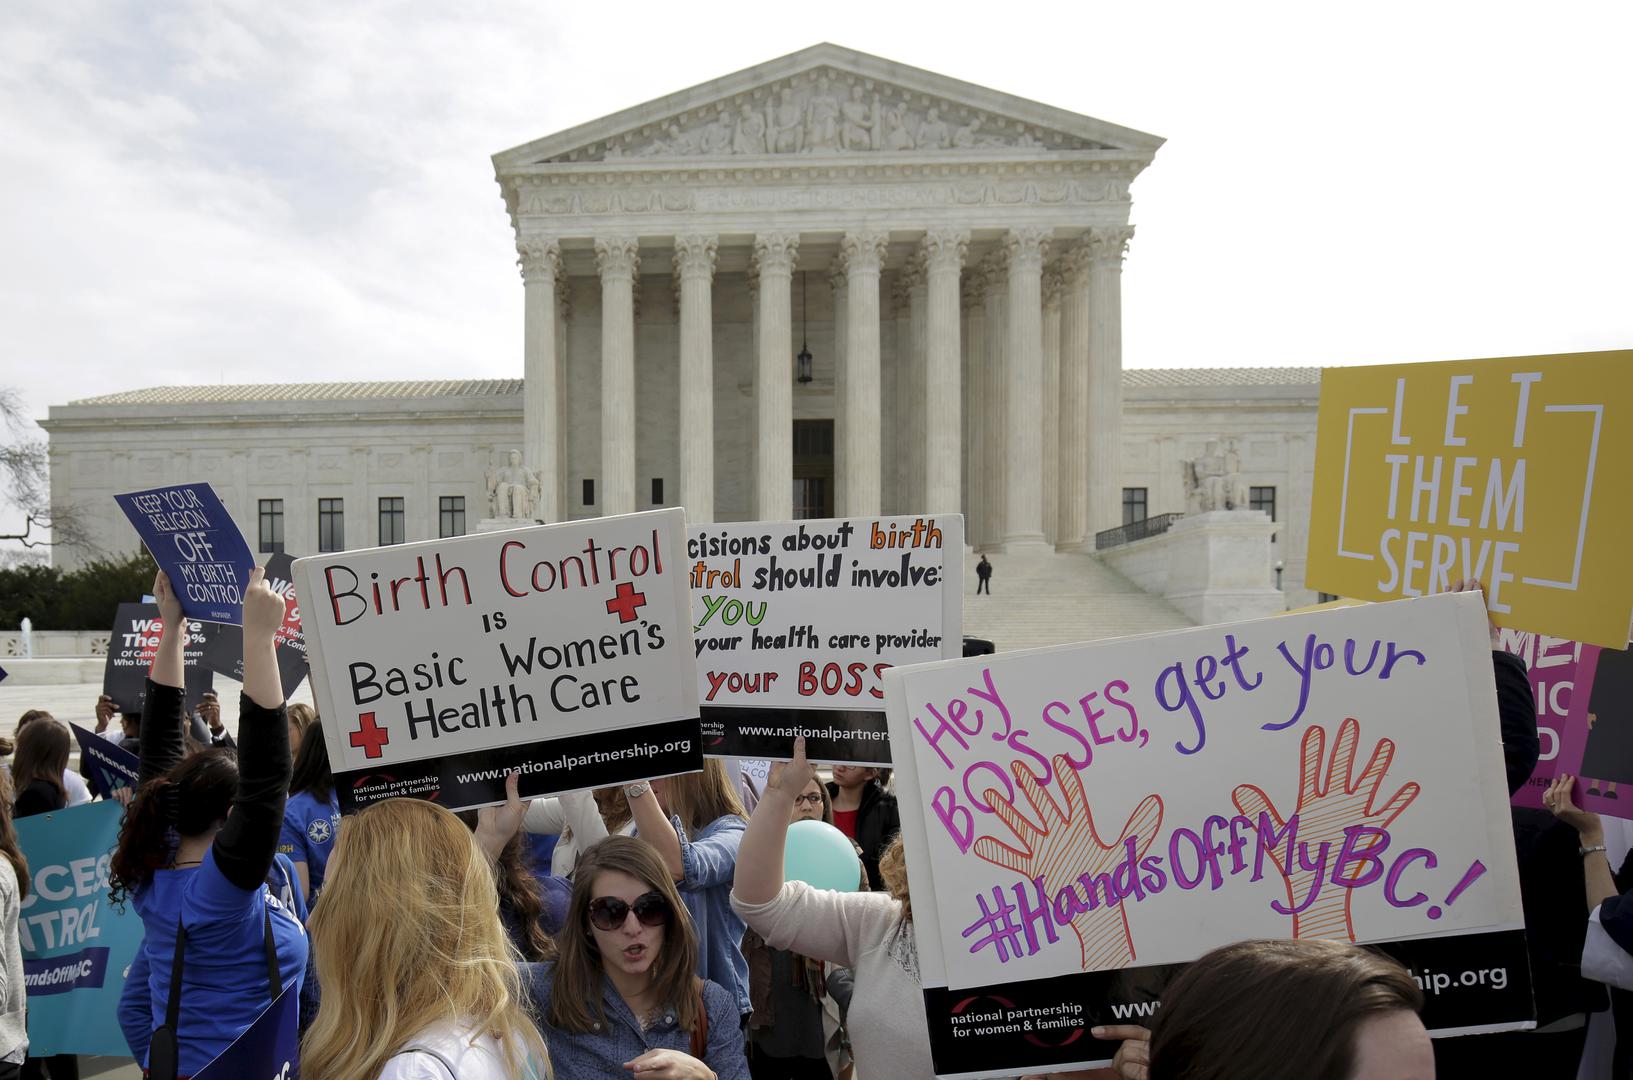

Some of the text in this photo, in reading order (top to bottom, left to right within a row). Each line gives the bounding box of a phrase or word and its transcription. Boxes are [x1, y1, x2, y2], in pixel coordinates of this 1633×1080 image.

[1391, 372, 1542, 447] LET
[132, 489, 204, 514] KEEP YOUR
[1385, 454, 1526, 532] THEM
[148, 509, 211, 531] RELIGION
[174, 532, 214, 561] OFF
[687, 519, 942, 559] cisions about birth
[179, 563, 237, 583] MY BIRTH
[324, 529, 663, 625] Birth Control
[689, 552, 942, 591] trol should involve:
[1378, 528, 1519, 613] SERVE
[187, 583, 243, 605] CONTROL
[132, 619, 162, 632] We
[482, 611, 507, 632] IS
[699, 595, 767, 626] YOU
[122, 633, 160, 647] The
[694, 625, 942, 658] your health care provider
[349, 620, 665, 704] Basic Women's
[705, 671, 778, 701] your
[405, 674, 640, 740] Health Care
[913, 668, 1012, 770] Hey
[931, 634, 1426, 855] BOSSES, get your
[456, 739, 691, 784] www.nationalpartnership.org
[353, 776, 439, 794] national partnership
[355, 783, 440, 802] for women & families
[961, 811, 1487, 963] #HandsOffMyBC!
[950, 1002, 1083, 1025] national partnership
[953, 1016, 1085, 1038] for women & families
